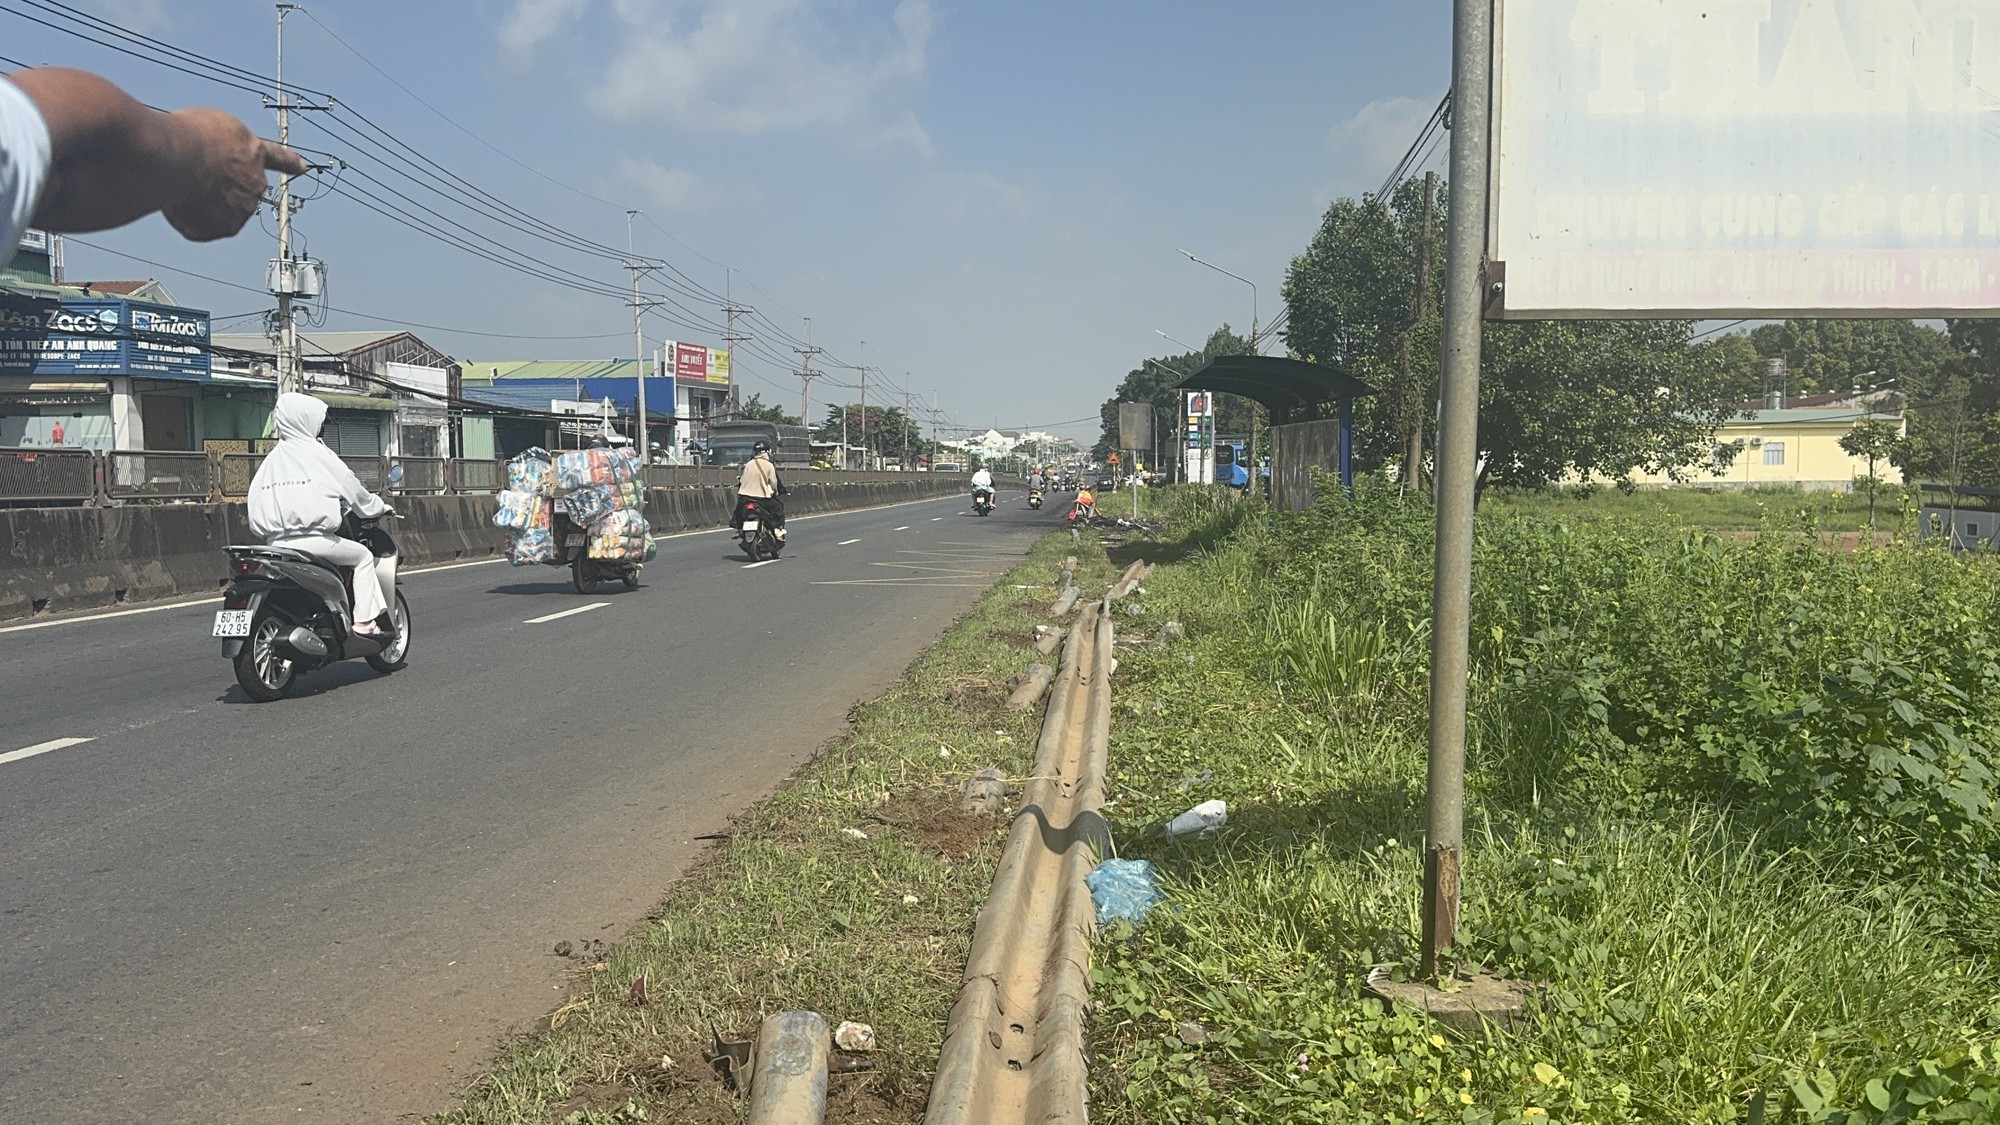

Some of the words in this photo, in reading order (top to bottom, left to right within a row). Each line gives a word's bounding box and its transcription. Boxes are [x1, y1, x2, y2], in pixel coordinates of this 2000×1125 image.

[1536, 186, 1687, 238] CHUYÊN
[1700, 193, 1805, 238] CUNG
[1818, 183, 1887, 237] CẤP
[1901, 183, 1965, 236] CÁC
[1831, 258, 1897, 298] THỊNH
[44, 308, 98, 332] Zacs
[25, 337, 49, 350] THÉP
[51, 340, 65, 351] AN
[87, 340, 118, 352] QUANG
[67, 352, 81, 360] ZACS
[220, 611, 247, 623] 60-H5
